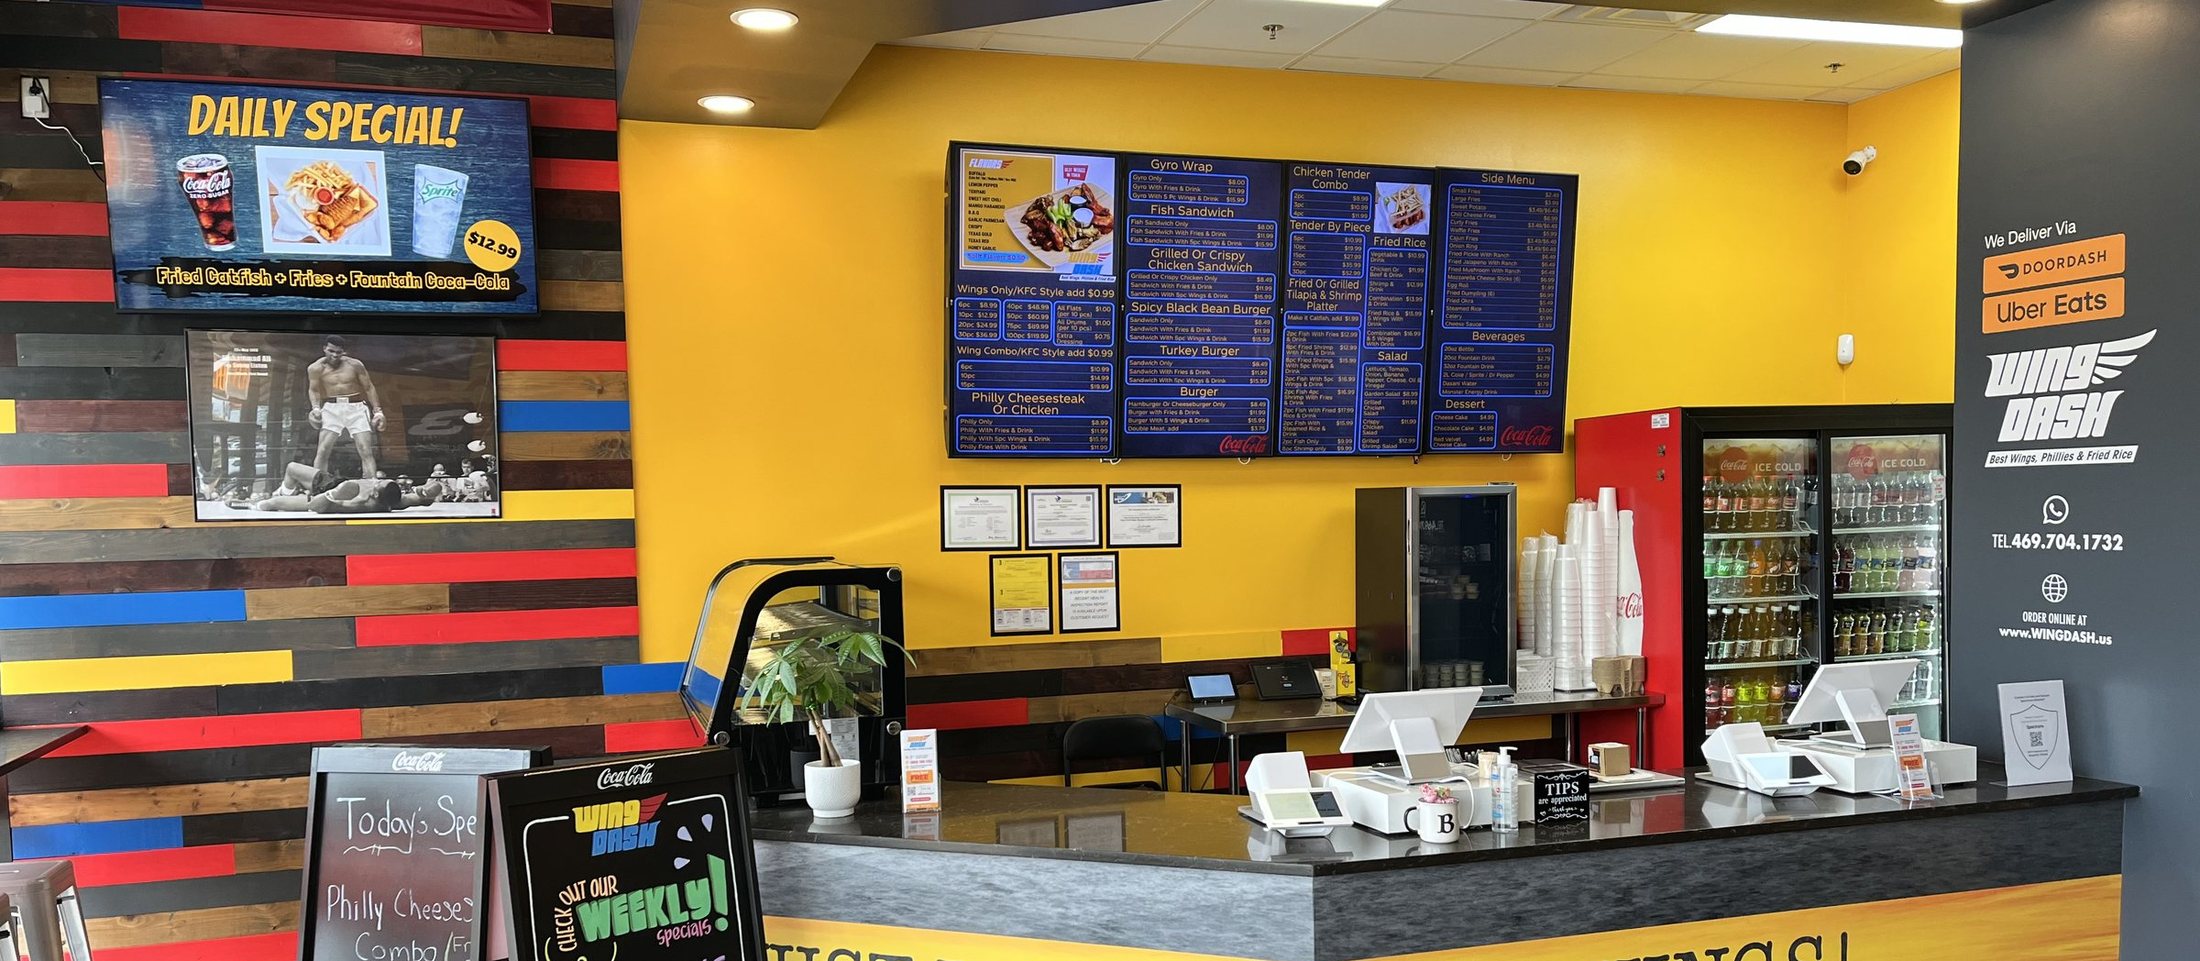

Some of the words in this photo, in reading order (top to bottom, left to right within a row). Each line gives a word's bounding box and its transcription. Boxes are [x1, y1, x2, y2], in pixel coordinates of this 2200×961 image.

[187, 94, 297, 138] DAILY
[304, 100, 464, 149] SPECIAL!
[1150, 159, 1179, 172] Gyro
[1182, 160, 1213, 173] Wrap
[1293, 166, 1333, 178] Chicken
[1336, 168, 1370, 179] Tender
[1312, 179, 1349, 190] Combo
[1481, 173, 1504, 184] Side
[1506, 174, 1536, 185] Menu
[208, 189, 230, 199] SUGAR
[422, 183, 457, 198] Sprite
[1150, 205, 1174, 215] Fish
[1178, 205, 1234, 218] Sandwich
[1290, 219, 1325, 231] Tender
[1328, 221, 1341, 233] By
[1343, 222, 1371, 233] Piece
[1373, 236, 1401, 247] Fried
[1403, 237, 1426, 248] Rice
[1984, 234, 2005, 250] We
[2008, 226, 2053, 246] Deliver
[2055, 220, 2077, 236] Via
[467, 230, 518, 260] $12.99
[1151, 248, 1188, 259] Grilled
[1192, 249, 1206, 259] Or
[1209, 250, 1245, 262] Crispy
[1148, 259, 1194, 271] Chicken
[1197, 261, 1253, 272] Sandwich
[2023, 250, 2107, 275] DOORDASH
[156, 266, 202, 285] Fried
[205, 267, 273, 286] Catfish
[274, 272, 287, 284] +
[289, 269, 334, 288] Fries
[335, 273, 348, 285] +
[350, 271, 423, 289] Fountain
[425, 272, 510, 291] Coca-Cola
[1289, 278, 1314, 288] Fried
[1315, 279, 1327, 289] Or
[1329, 279, 1360, 290] Grilled
[957, 285, 988, 295] Wings
[991, 285, 1037, 296] Only/KFC
[1039, 285, 1064, 297] Style
[1066, 288, 1085, 297] add
[1088, 289, 1115, 298] $0.99
[1287, 289, 1318, 301] Tilapia
[1319, 291, 1326, 300] &
[1329, 290, 1362, 302] Shrimp
[1131, 301, 1163, 314] Spicy
[1166, 303, 1198, 313] Black
[1201, 303, 1230, 314] Bean
[1233, 304, 1271, 316] Burger
[1307, 301, 1338, 311] Platter
[1997, 301, 2047, 323] Uber
[2054, 292, 2107, 316] Eats
[1472, 331, 1526, 342] Beverages
[957, 346, 982, 356] Wing
[984, 346, 1039, 356] Combo/KFC
[1042, 348, 1065, 358] Style
[1067, 349, 1085, 357] add
[1088, 350, 1113, 358] $0.99
[1160, 345, 1199, 357] Turkey
[1201, 346, 1239, 357] Burger
[1377, 351, 1408, 361] Salad
[971, 392, 1005, 404] Philly
[1008, 392, 1085, 404] Cheesesteak
[1180, 387, 1219, 398] Burger
[993, 405, 1009, 414] Or
[1011, 404, 1059, 415] Chicken
[1445, 399, 1485, 408] Dessert
[1997, 390, 2125, 442] DASH
[1881, 459, 1897, 468] ICE
[1900, 459, 1926, 467] COLD
[1989, 453, 2008, 465] Best
[2010, 452, 2038, 464] Wings,
[2041, 451, 2075, 463] Phillies
[2077, 450, 2084, 461] &
[2087, 450, 2110, 461] Fried
[2112, 449, 2133, 460] Rice
[1755, 463, 1772, 472] ICE
[1775, 463, 1801, 472] COLD
[2022, 611, 2047, 624] ORDER
[2049, 613, 2077, 625] ONLINE
[2078, 615, 2087, 626] AT
[1999, 627, 2113, 646] www.WINGDASH.us
[391, 750, 448, 773] Coca-Cola
[596, 762, 655, 790] Coca-Cola
[1545, 781, 1580, 796] TIPS
[1550, 793, 1587, 804] appreciated
[336, 797, 428, 854] Today's
[1437, 814, 1455, 834] B
[591, 820, 662, 857] DASH
[558, 879, 587, 905] OUT
[589, 875, 619, 899] OUR
[575, 854, 729, 943] WEEKLY!
[326, 883, 384, 932] Philly
[554, 907, 578, 952] CHECK
[656, 918, 712, 947] specials
[354, 931, 438, 961] Combo
